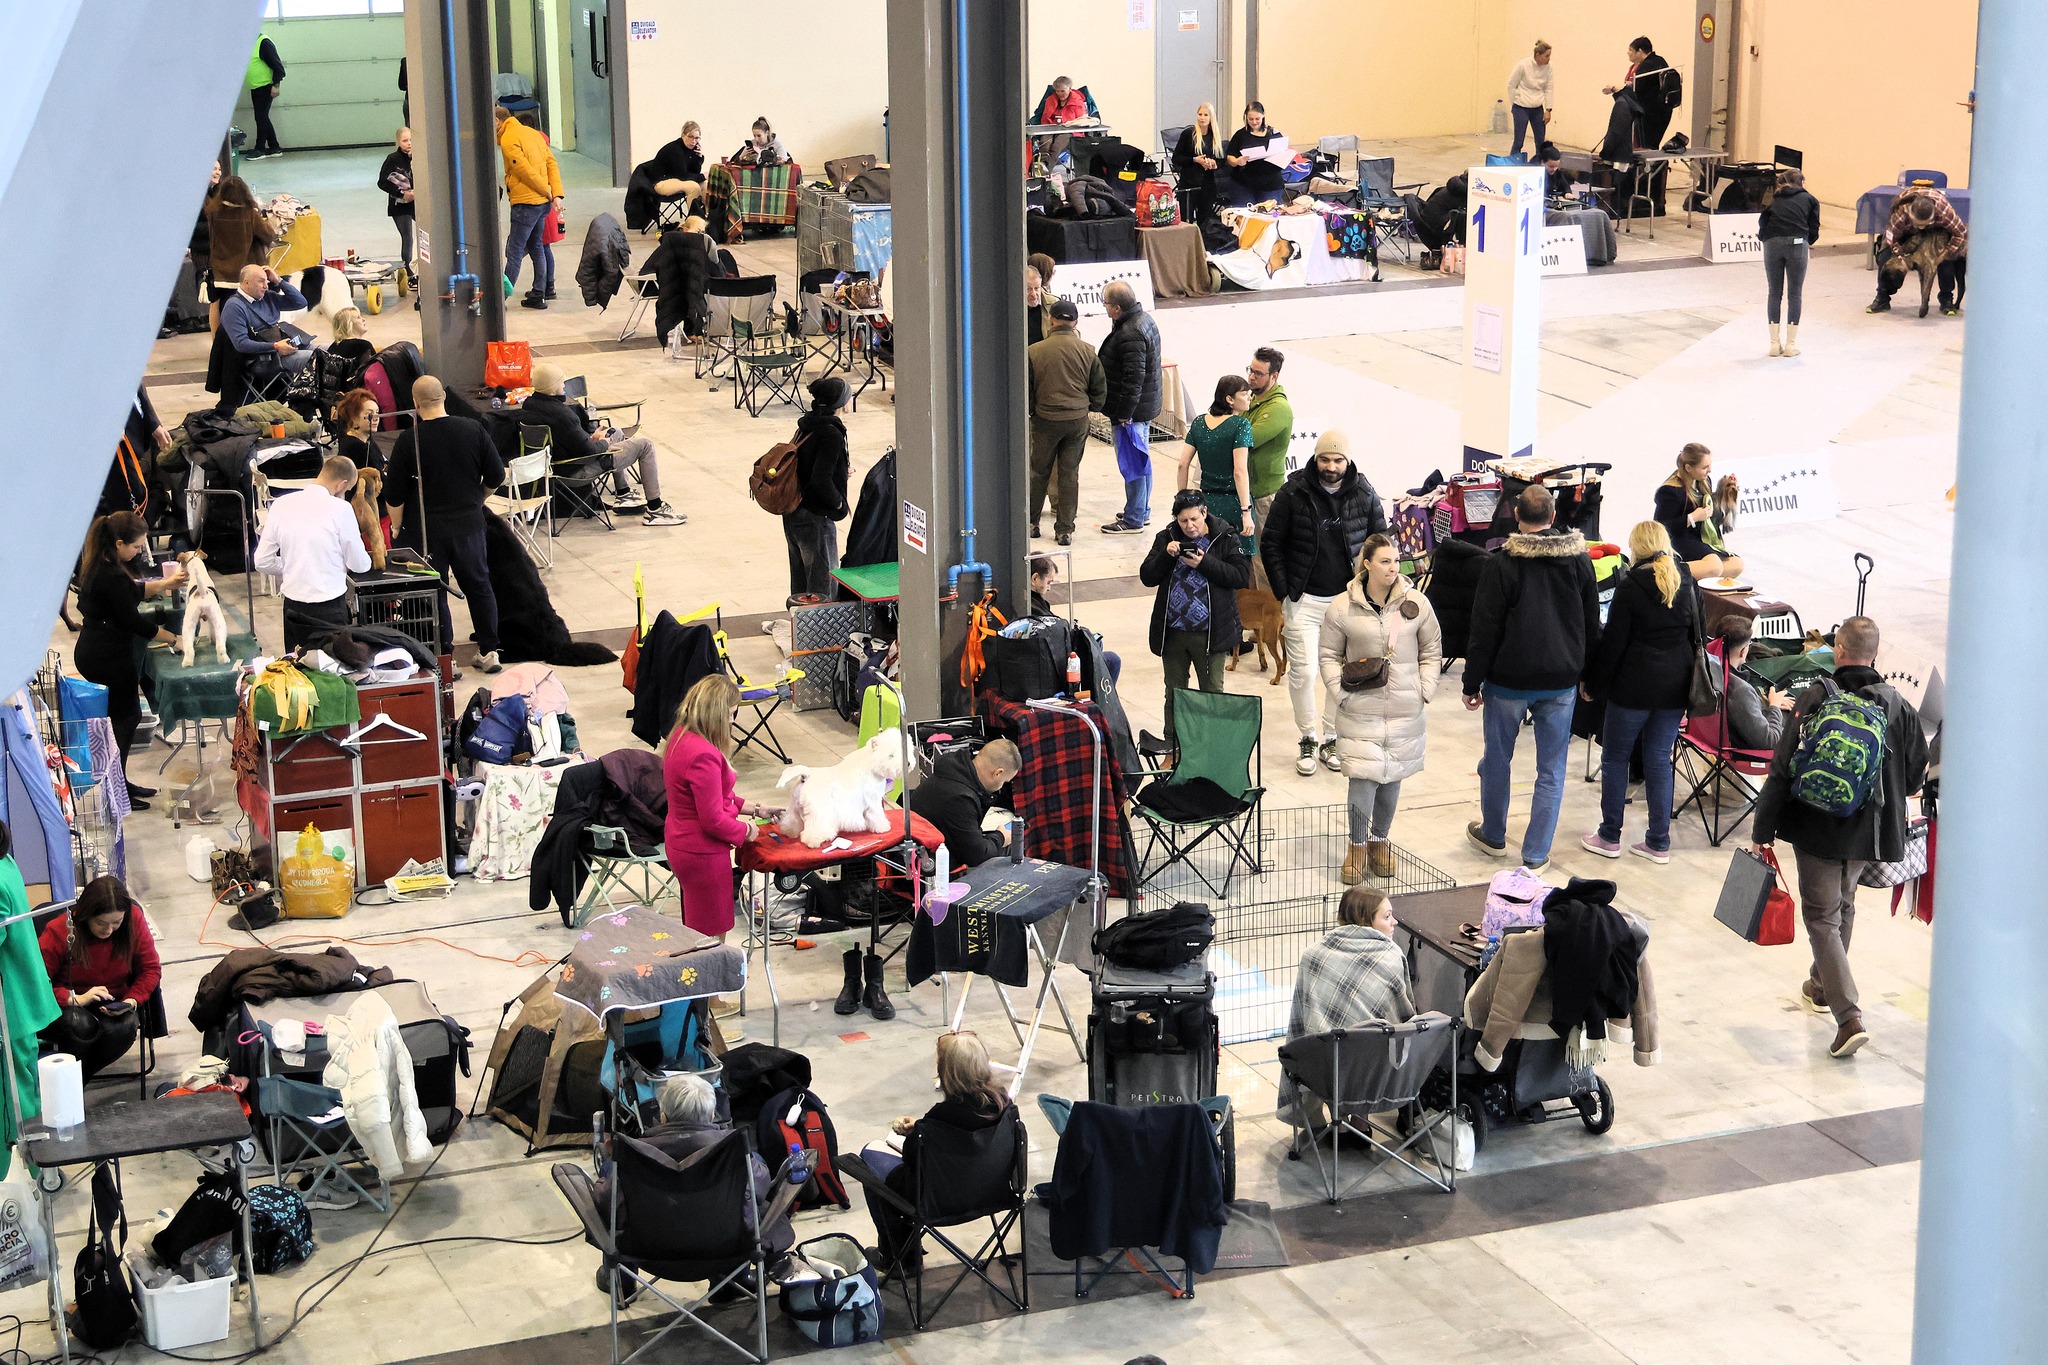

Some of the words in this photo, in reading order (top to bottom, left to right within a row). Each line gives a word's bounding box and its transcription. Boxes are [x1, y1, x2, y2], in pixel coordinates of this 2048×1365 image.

[1472, 204, 1486, 253] 1
[1520, 207, 1530, 256] 1
[1720, 242, 1762, 253] PLATIN
[1060, 292, 1105, 305] PLATIN
[1740, 494, 1798, 515] ATINUM
[967, 881, 1022, 955] WESTMINSTER
[980, 909, 991, 953] KENNEL
[0, 1229, 19, 1245] TRO
[0, 1237, 23, 1255] RCIA
